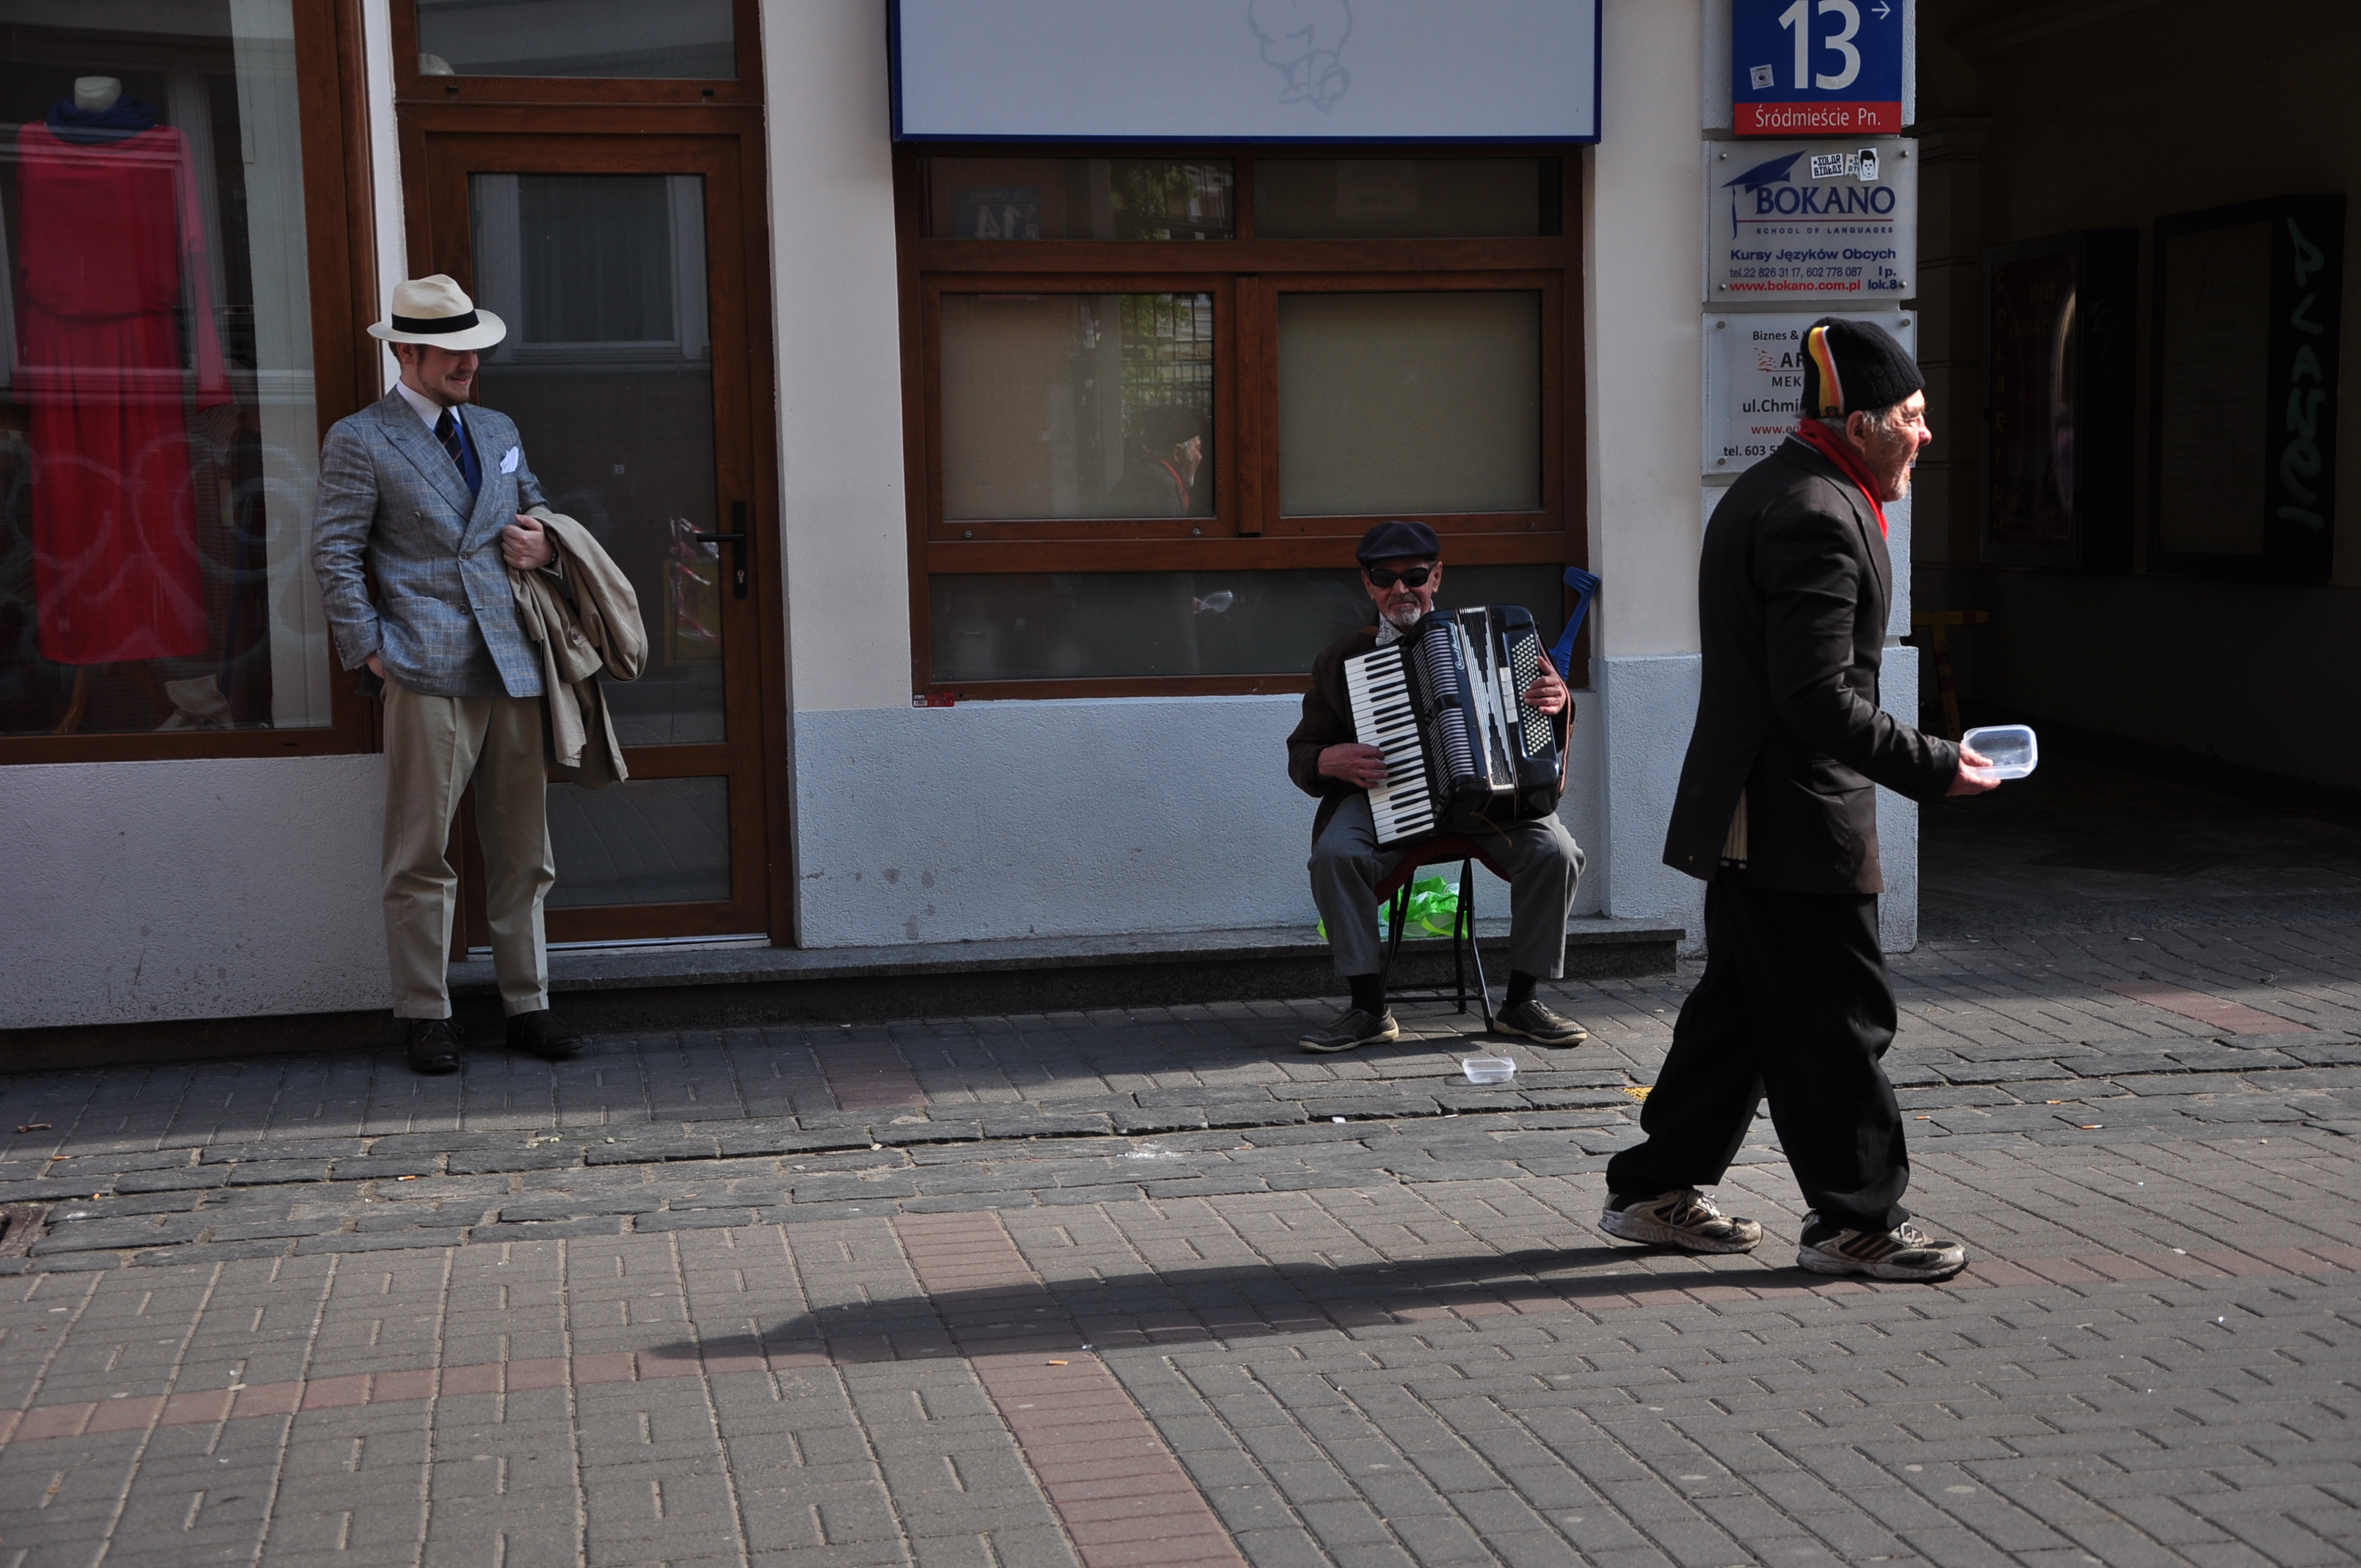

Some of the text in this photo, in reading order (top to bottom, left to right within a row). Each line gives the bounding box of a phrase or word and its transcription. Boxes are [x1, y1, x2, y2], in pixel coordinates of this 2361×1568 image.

[1778, 0, 1861, 90] 13
[1755, 104, 1881, 128] Śródmieście Pn.
[1817, 154, 1841, 167] SOLAR
[1755, 186, 1896, 215] BOKANO
[1827, 226, 1893, 234] LANGUAGES
[1730, 247, 1896, 263] Kursy Języków Obcych
[1730, 267, 1756, 278] tel.22
[1758, 267, 1777, 278] 826
[1806, 267, 1824, 278] 602
[1827, 266, 1843, 277] 778
[1845, 266, 1863, 277] 087
[1885, 269, 1897, 279] p.
[1730, 279, 1898, 292] www.bokano.com.pl lok.8
[1752, 330, 1788, 341] Biznes
[1790, 330, 1799, 341] &
[1780, 352, 1805, 368] AR
[1771, 376, 1802, 388] MEK
[1742, 399, 1799, 413] ul.Chmi
[1723, 446, 1742, 457] tel.
[1744, 445, 1766, 457] 603
